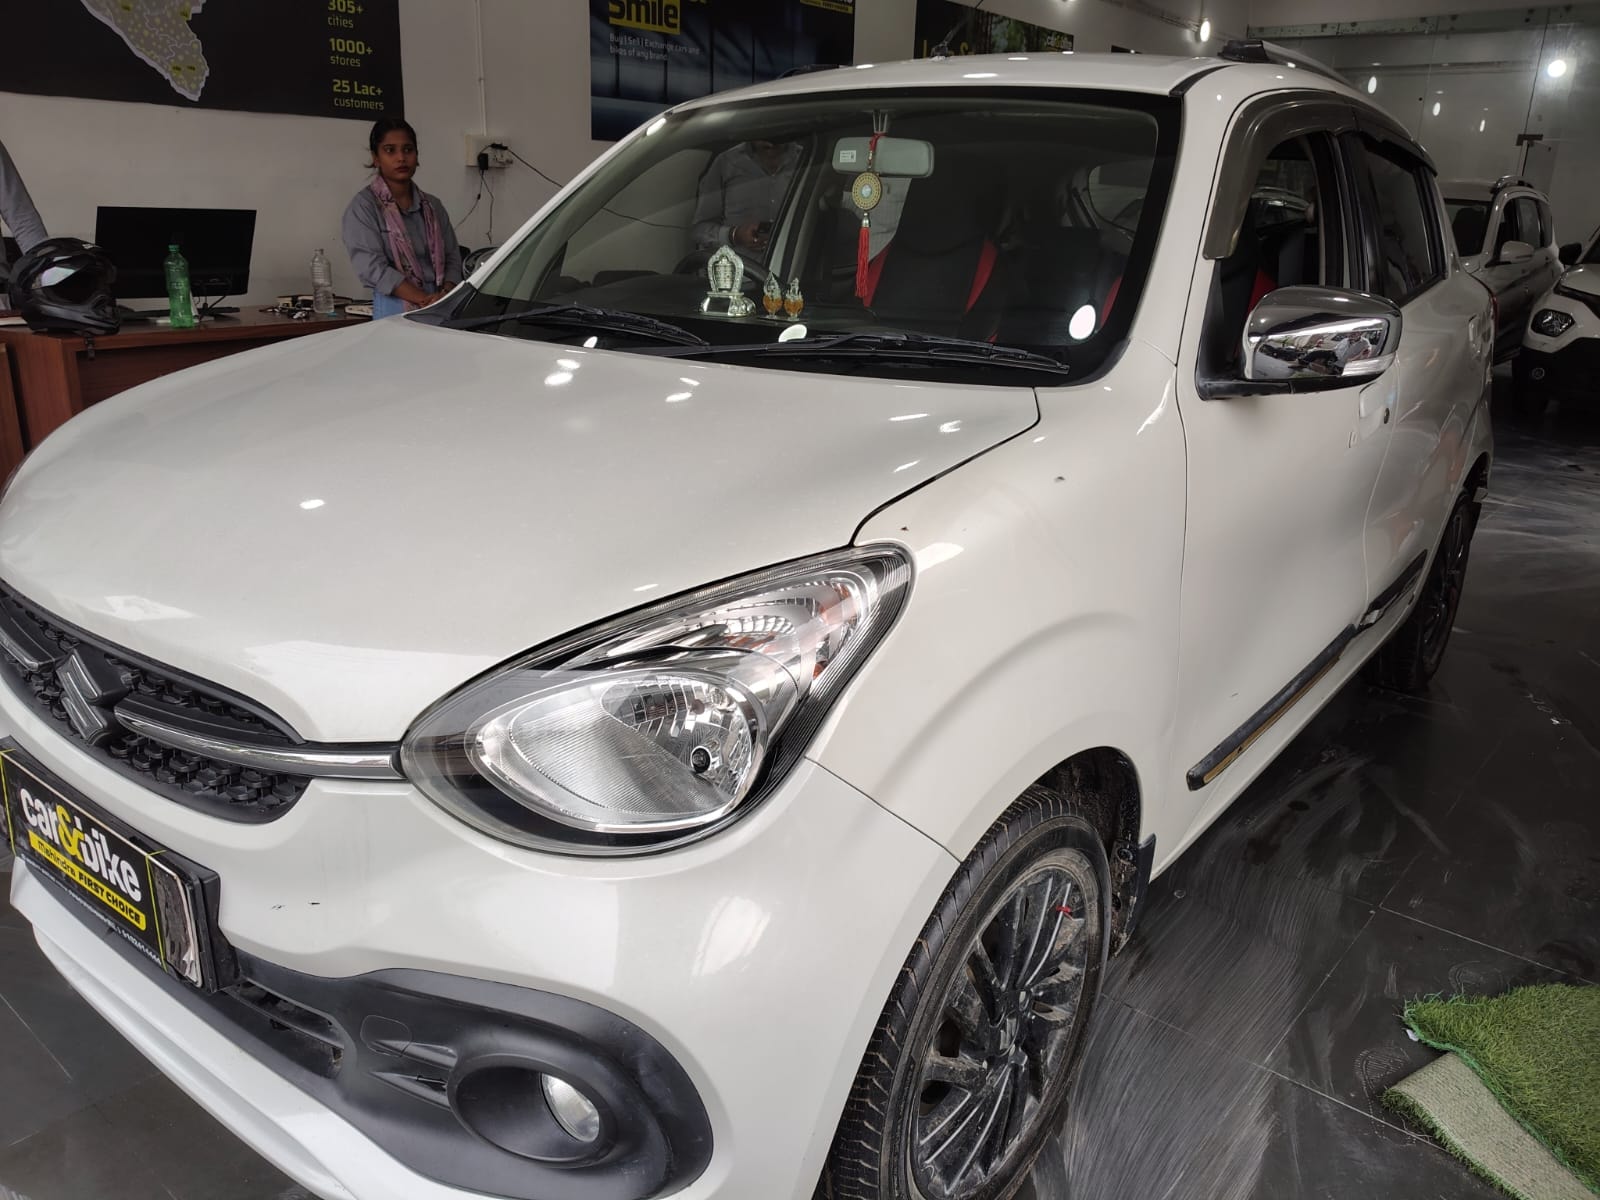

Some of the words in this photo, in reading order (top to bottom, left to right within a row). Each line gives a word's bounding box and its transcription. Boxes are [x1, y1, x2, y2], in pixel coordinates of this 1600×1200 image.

[328, 0, 363, 14] 305+
[608, 0, 679, 29] Smile
[328, 15, 354, 29] cities
[329, 38, 373, 55] 1000+
[609, 32, 623, 46] Buy
[330, 55, 361, 67] stores
[333, 79, 350, 93] 25
[354, 81, 383, 96] Lac+
[334, 97, 384, 111] customers
[20, 788, 142, 903] car&bike
[78, 873, 106, 899] FIRST
[106, 891, 141, 924] CHOICE
